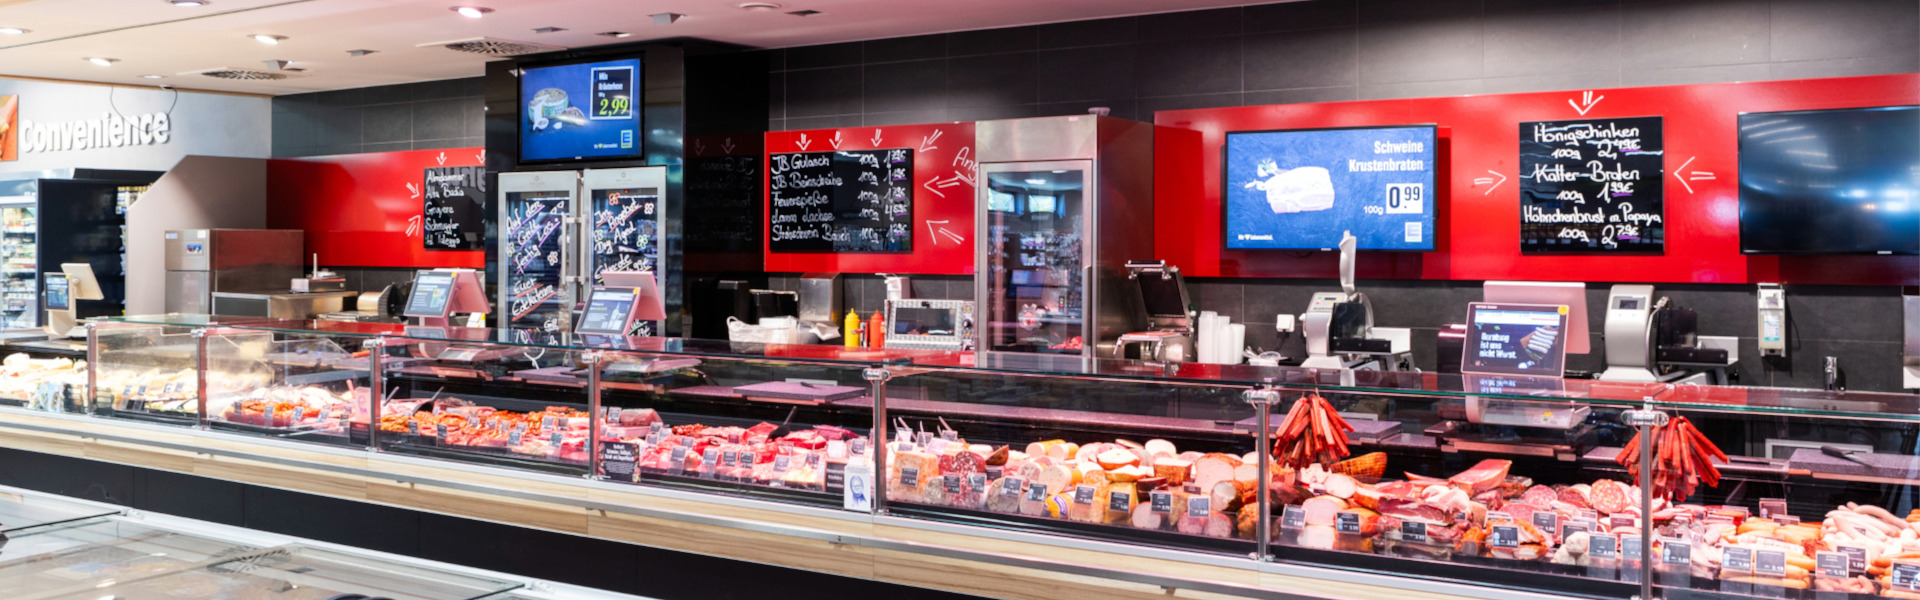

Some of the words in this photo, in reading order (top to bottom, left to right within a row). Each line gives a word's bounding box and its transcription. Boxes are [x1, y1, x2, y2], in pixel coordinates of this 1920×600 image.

[599, 98, 629, 117] 2,99
[20, 112, 171, 152] Convenience
[1534, 122, 1640, 147] Honigschinken
[1374, 140, 1424, 154] Schweine
[1551, 148, 1582, 160] 100g
[791, 154, 830, 169] Gulasch
[1349, 159, 1424, 173] Krustenbraten
[1586, 160, 1640, 182] Braten
[1556, 190, 1585, 204] 100g
[1363, 205, 1384, 215] 100g
[1618, 202, 1662, 227] Papaya
[1558, 227, 1590, 242] 100g
